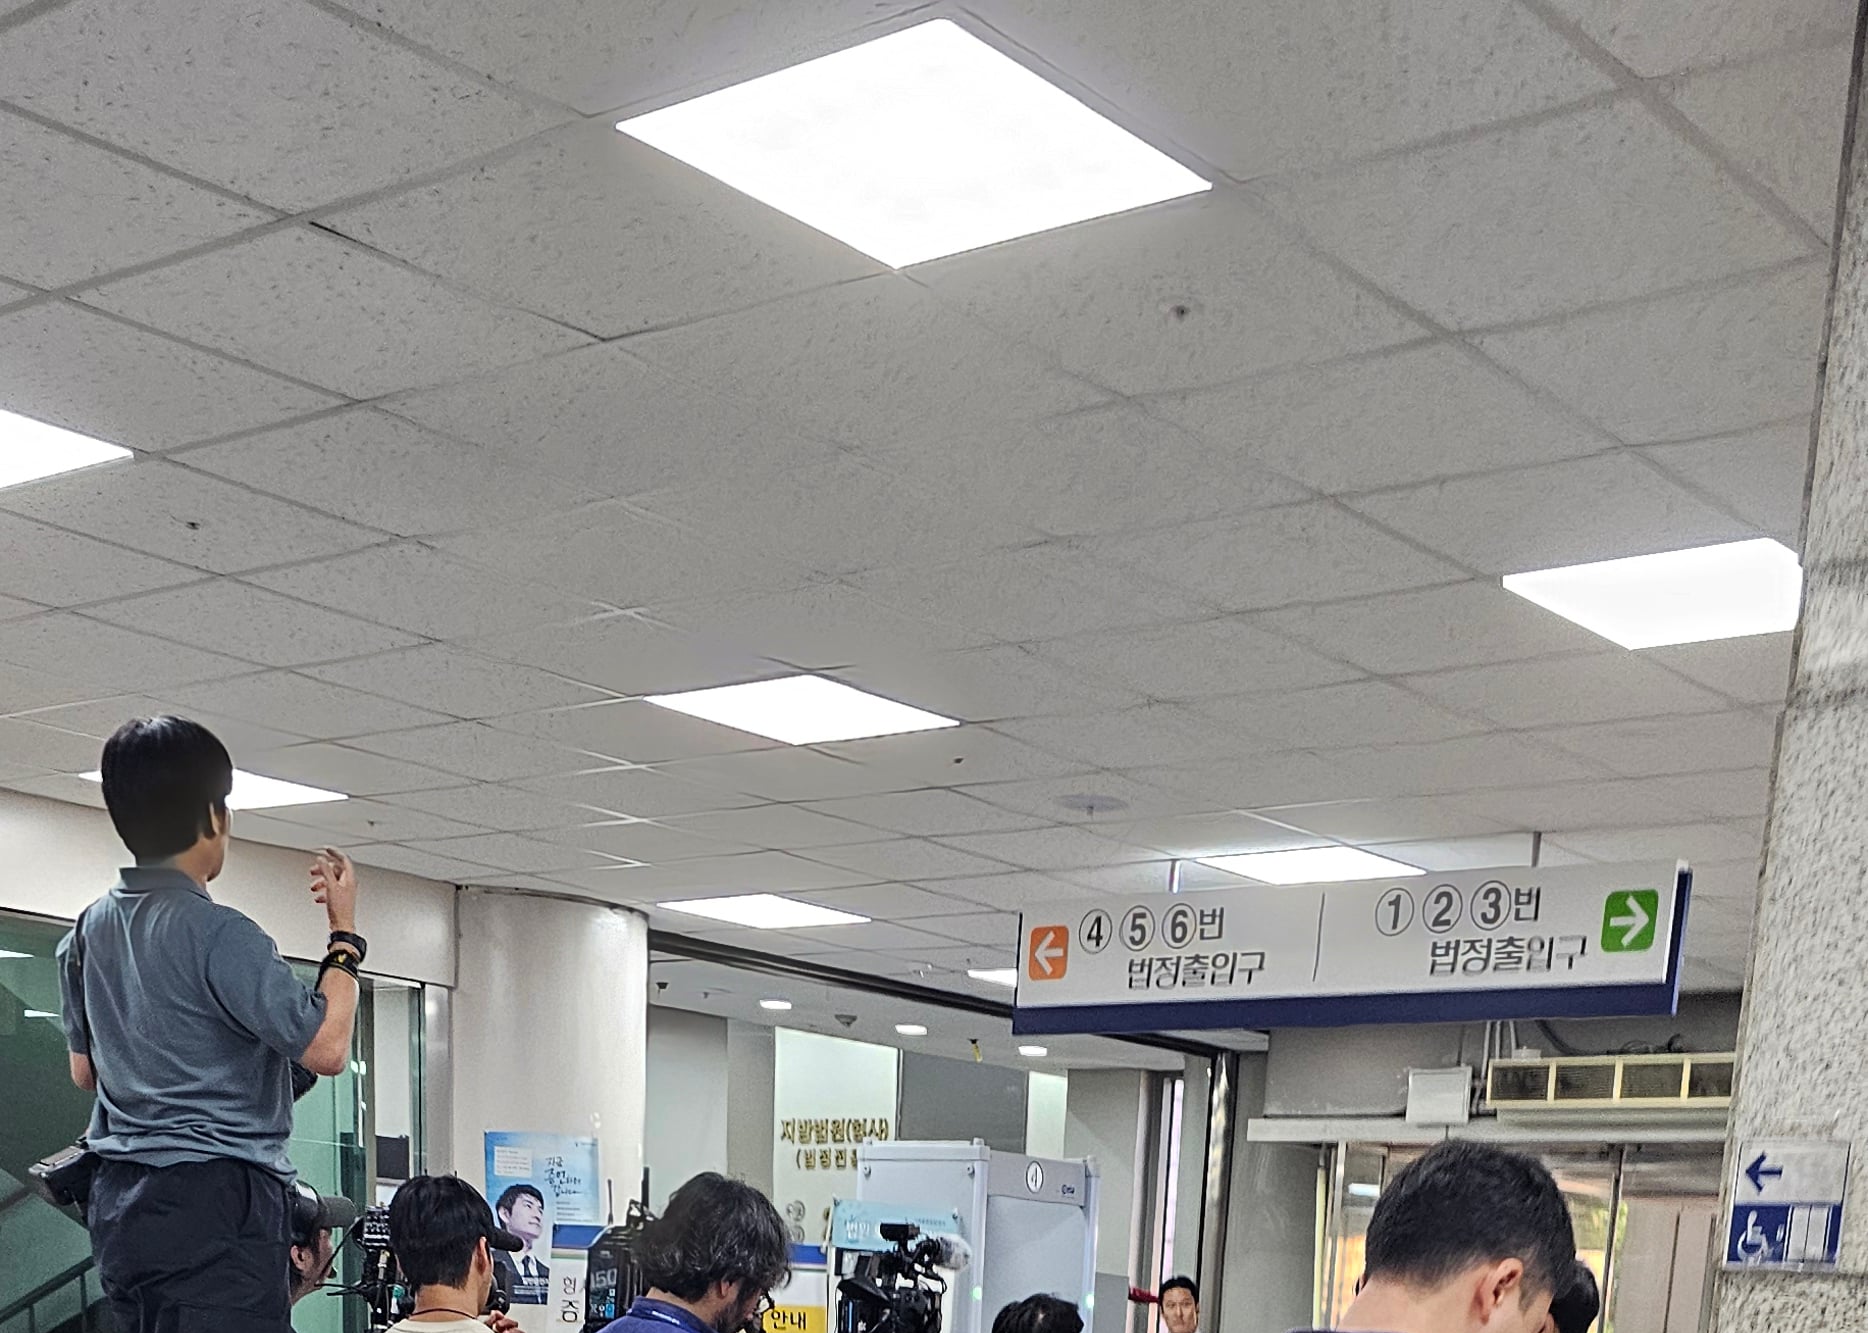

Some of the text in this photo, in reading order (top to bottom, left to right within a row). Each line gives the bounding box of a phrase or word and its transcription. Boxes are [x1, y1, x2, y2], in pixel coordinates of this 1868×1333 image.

[1128, 951, 1267, 990] 법정출입구
[1429, 935, 1589, 977] 법정출입구
[771, 1310, 807, 1332] 안내
